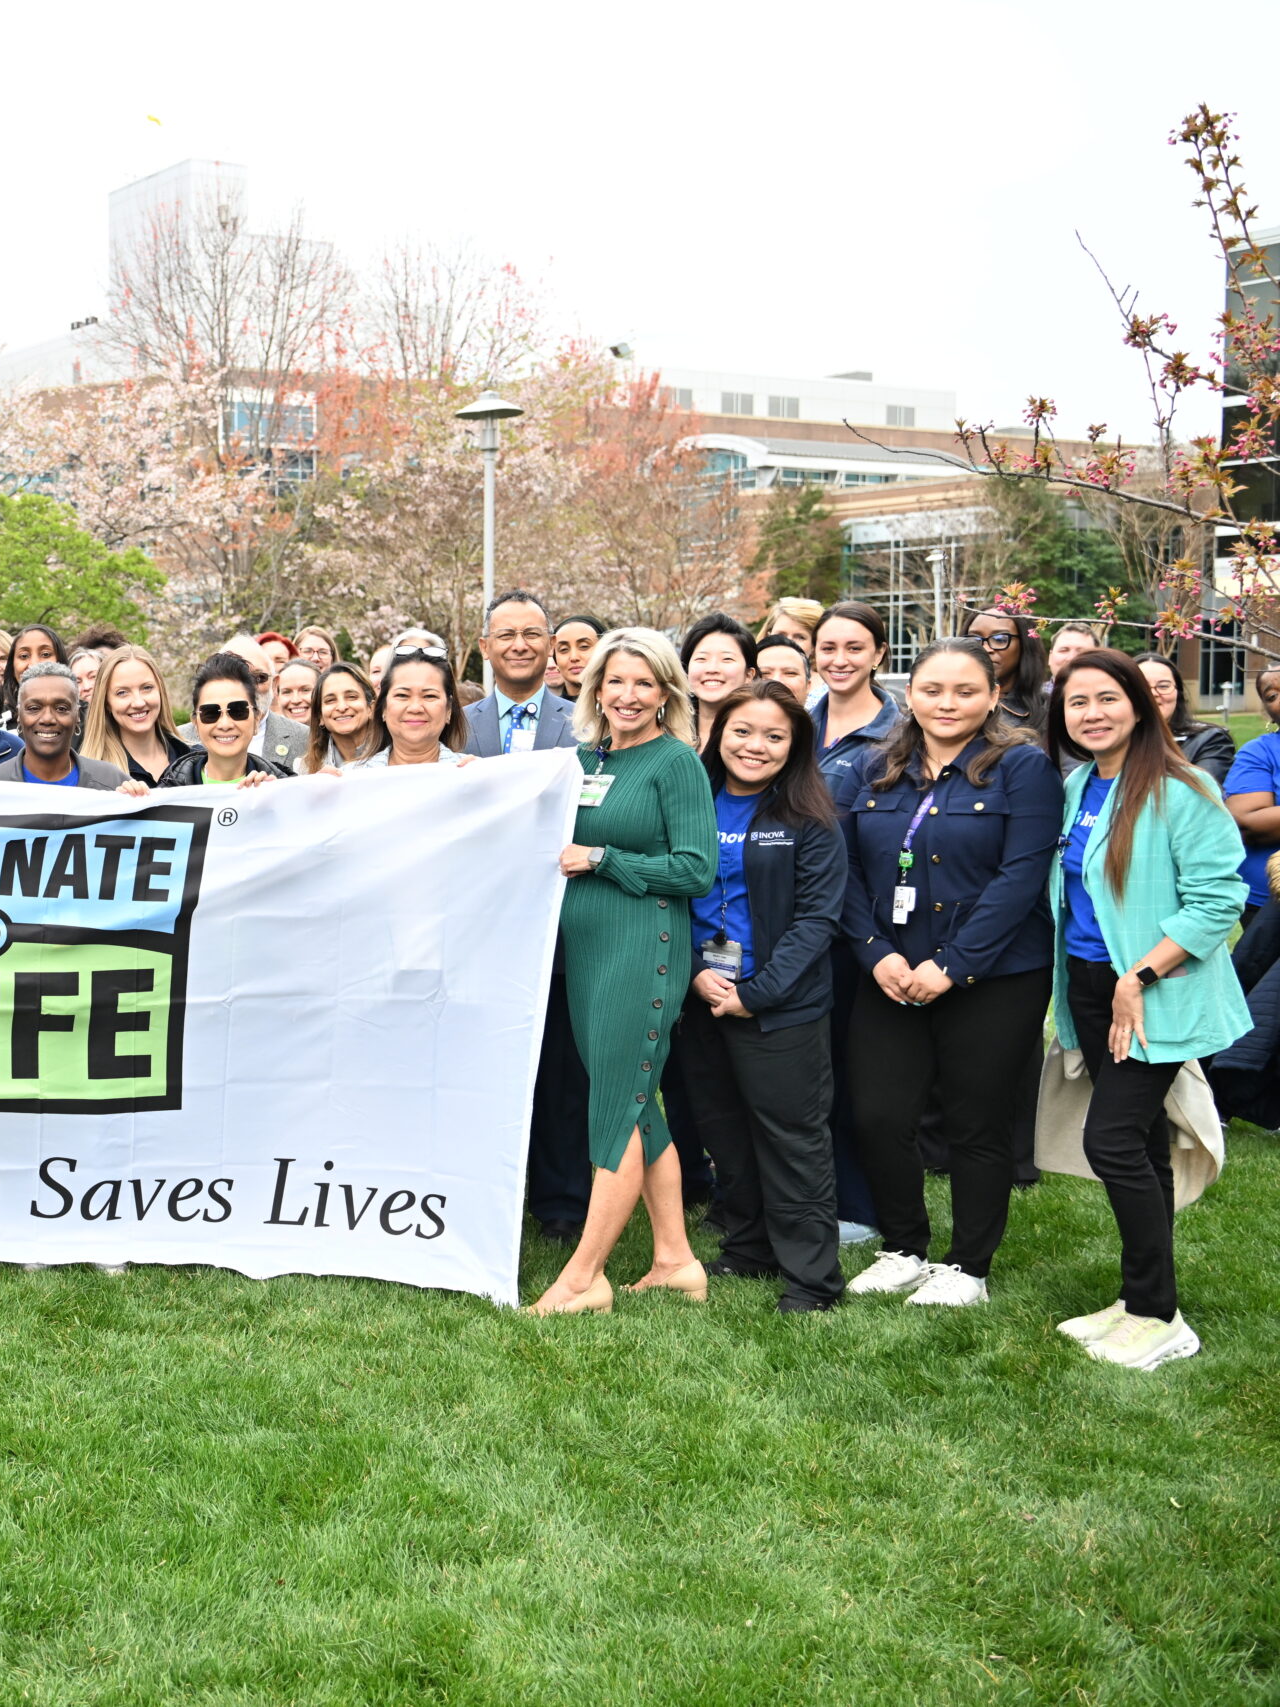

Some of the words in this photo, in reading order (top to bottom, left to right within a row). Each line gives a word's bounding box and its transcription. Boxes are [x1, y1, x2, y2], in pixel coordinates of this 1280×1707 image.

[759, 831, 785, 839] INOVA
[31, 1157, 233, 1222] Saves
[264, 1159, 446, 1239] Lives
